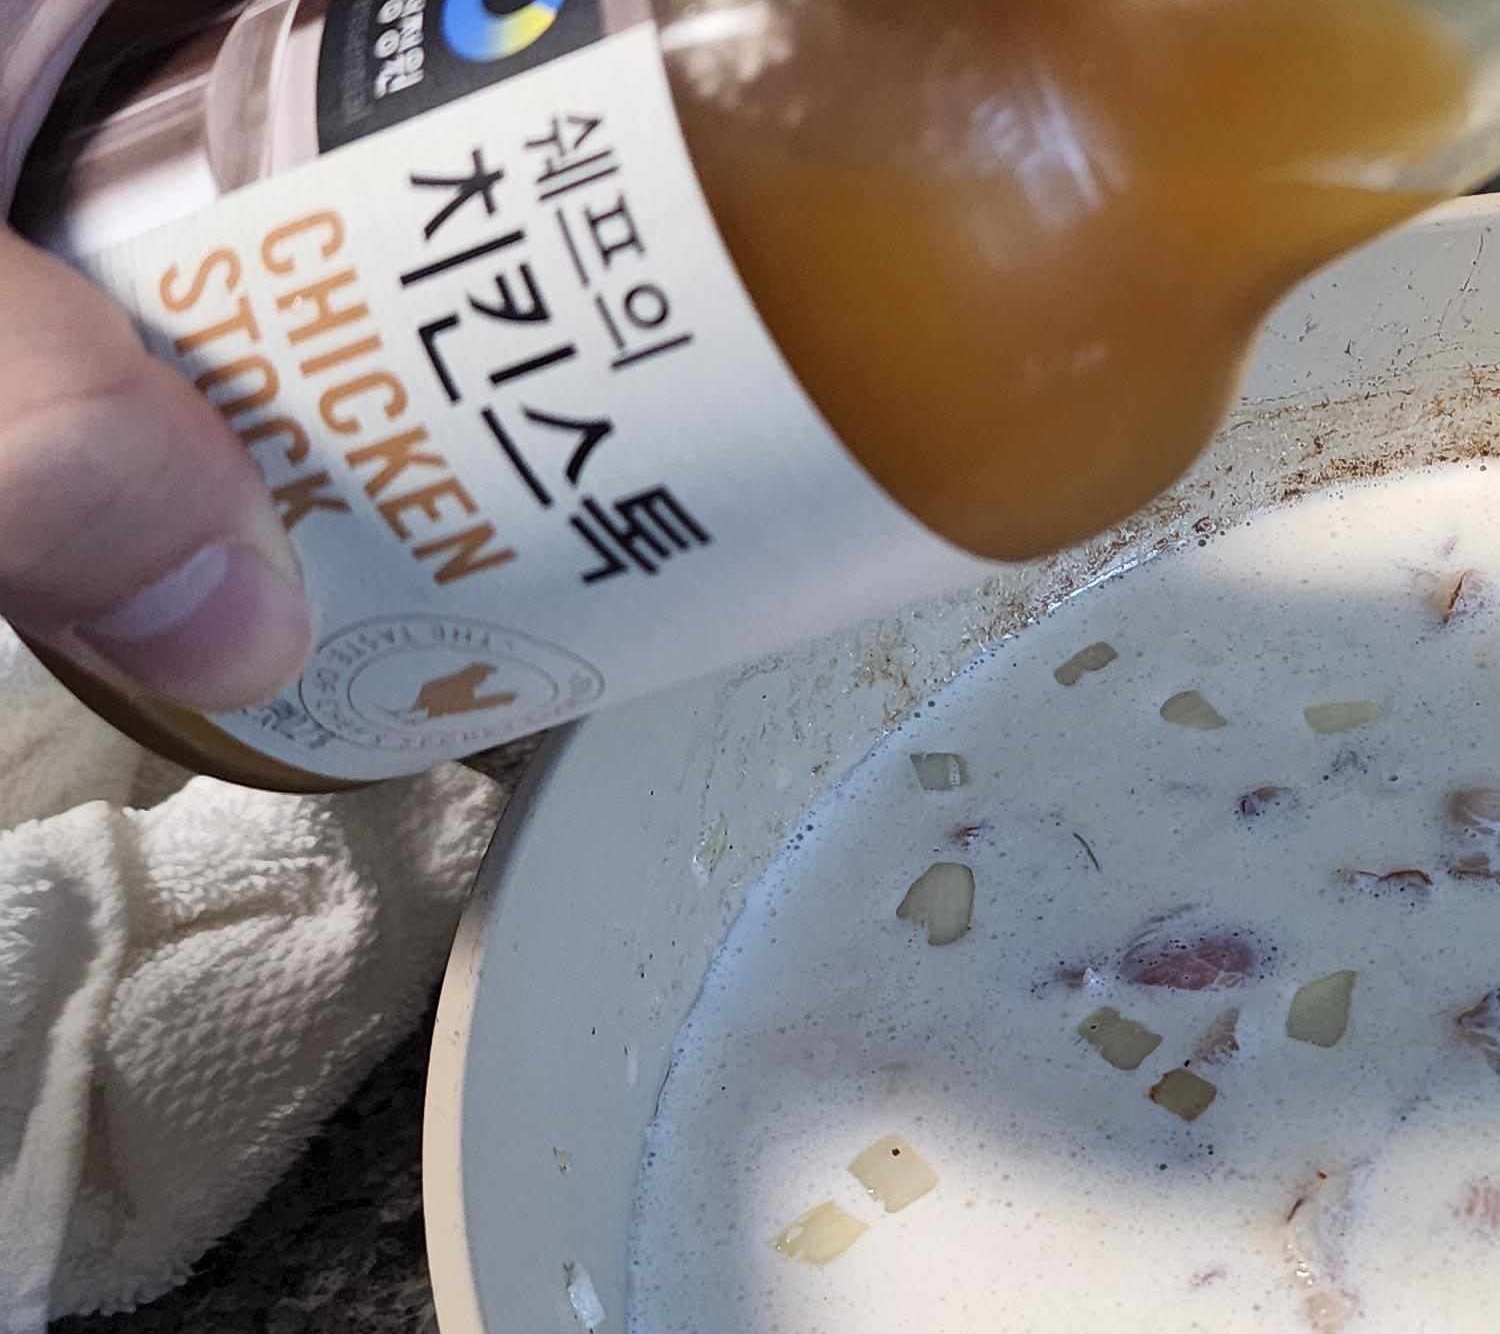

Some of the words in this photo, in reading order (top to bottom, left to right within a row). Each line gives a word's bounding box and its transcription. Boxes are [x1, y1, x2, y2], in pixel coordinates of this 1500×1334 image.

[260, 208, 516, 585] CHICKEN
[400, 147, 713, 586] 치킨스톡
[523, 112, 694, 370] 쉐프의
